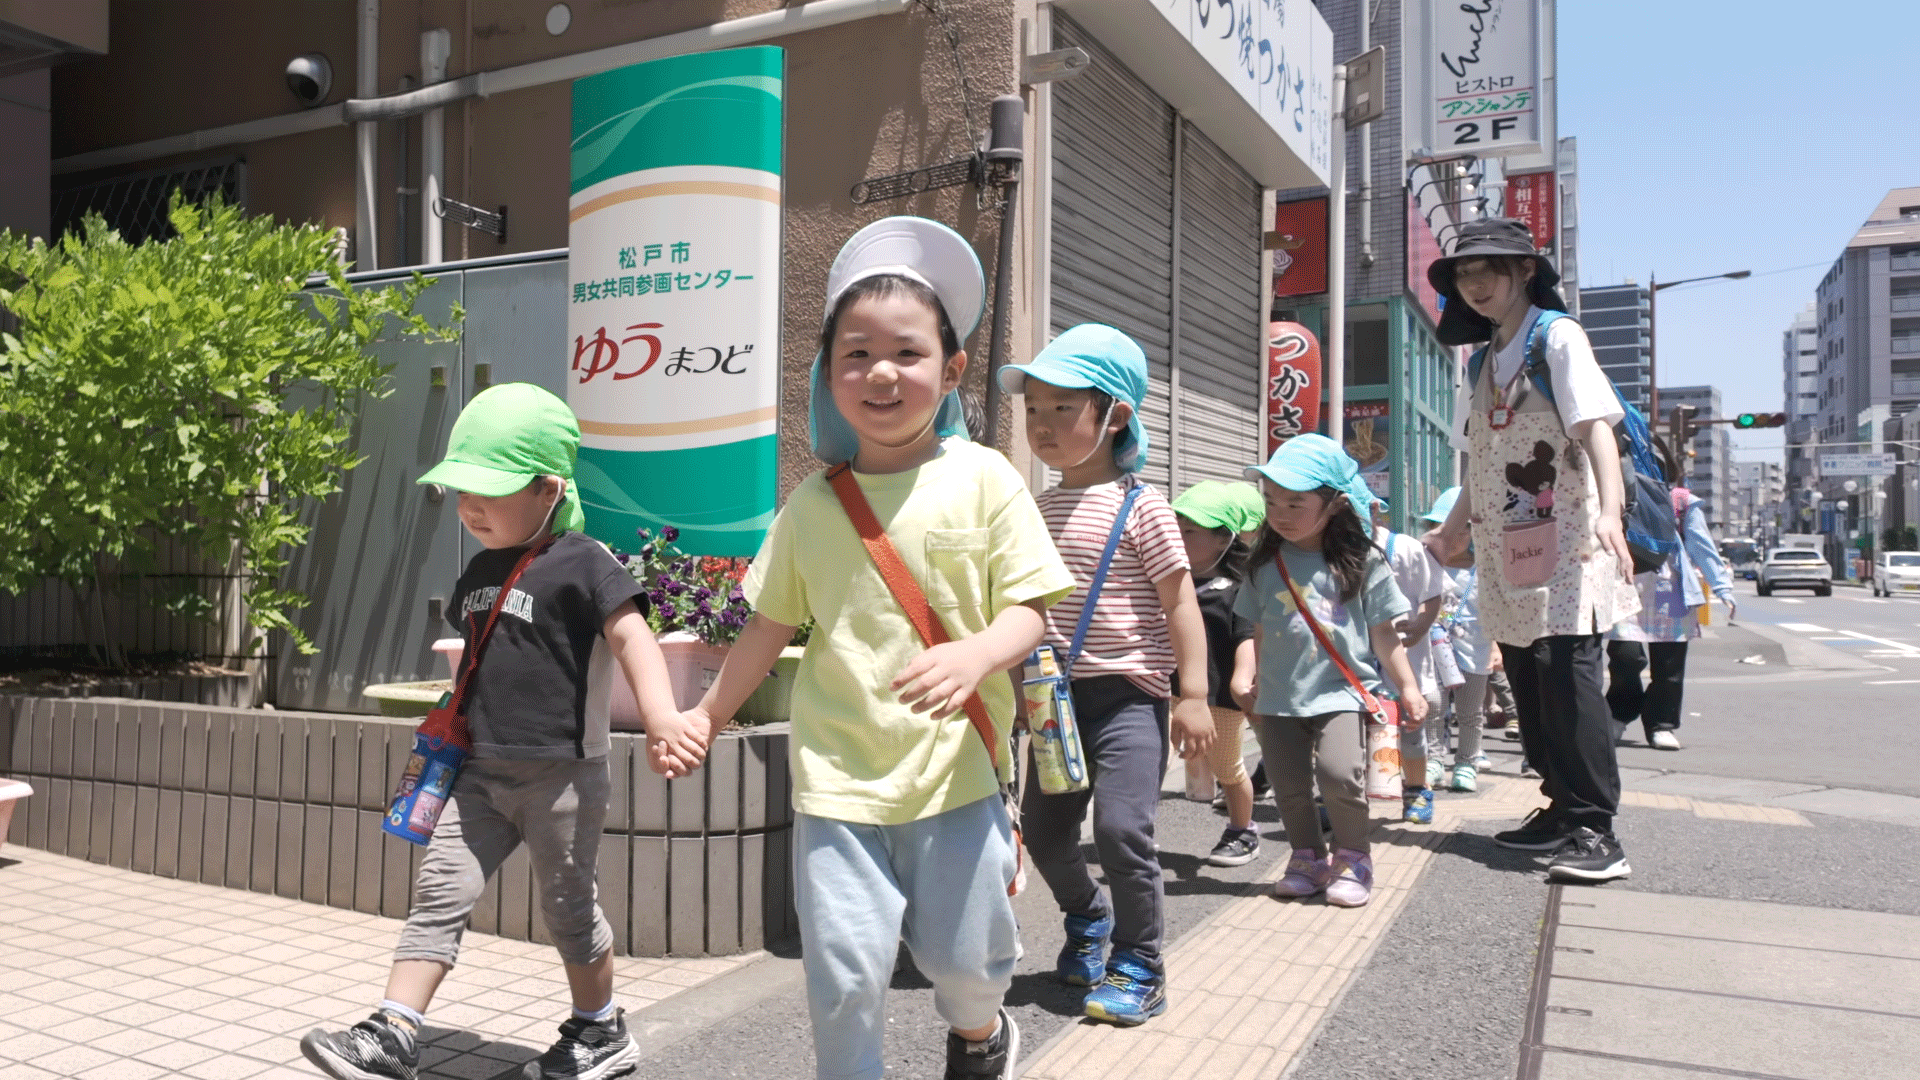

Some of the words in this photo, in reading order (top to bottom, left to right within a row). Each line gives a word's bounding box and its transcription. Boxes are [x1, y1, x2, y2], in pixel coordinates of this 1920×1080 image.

[1442, 92, 1532, 118] アンシャンテ
[1454, 116, 1518, 145] 2F
[618, 241, 691, 270] 松戸市
[572, 269, 754, 304] 男女共同参画センター
[1270, 332, 1310, 442] つかさ
[1510, 547, 1543, 564] Jackie
